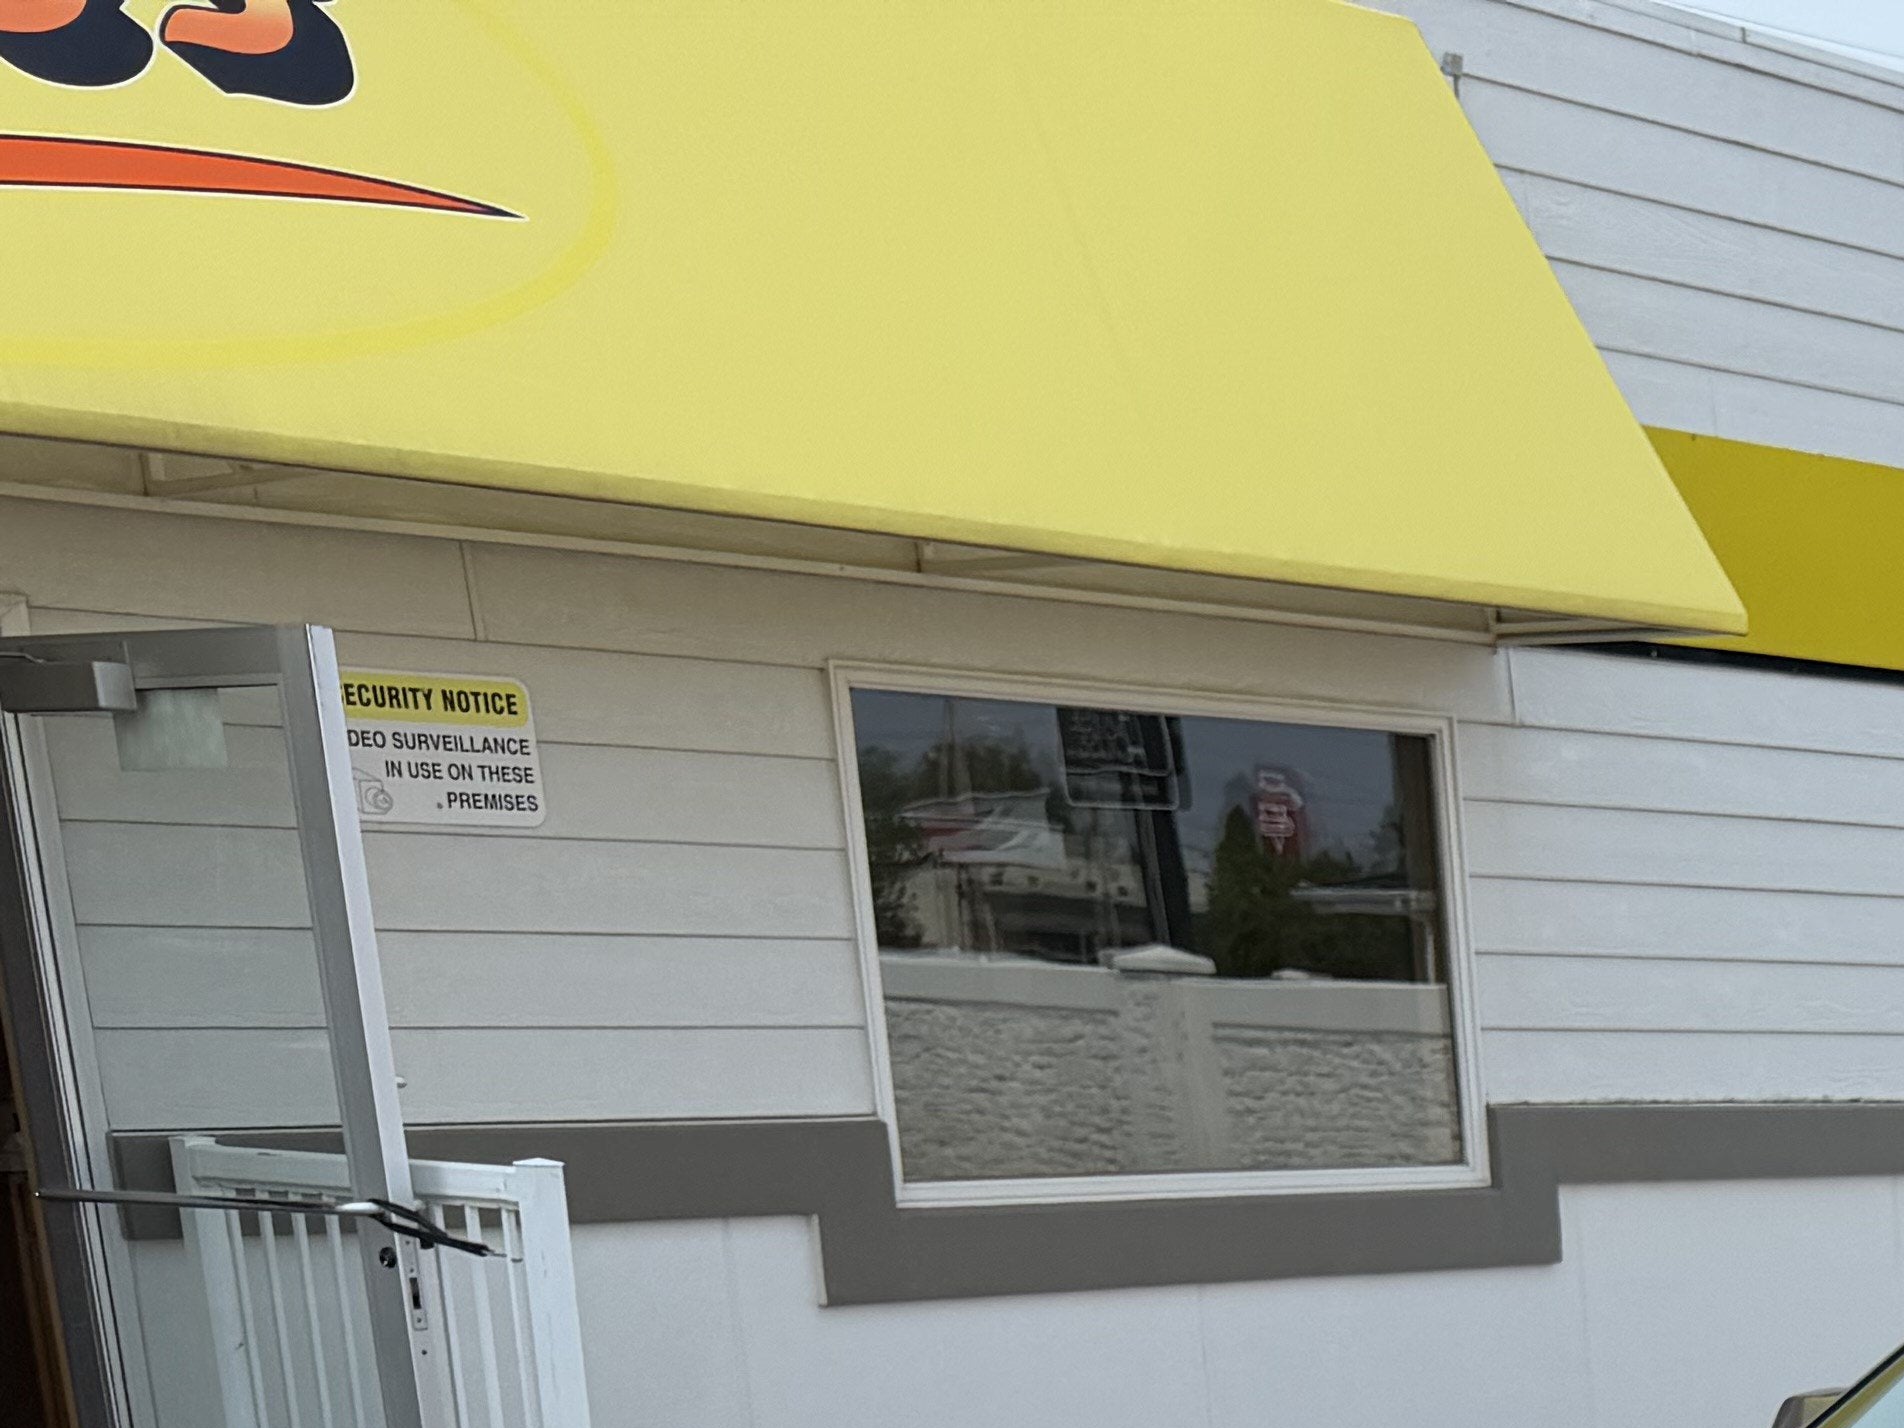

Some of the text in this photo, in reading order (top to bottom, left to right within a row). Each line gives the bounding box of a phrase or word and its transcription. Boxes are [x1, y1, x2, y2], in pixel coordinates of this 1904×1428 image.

[341, 683, 519, 716] ECURITY NOTICE
[348, 729, 532, 756] DEO SURVEILLANCE
[385, 760, 536, 784] IN USE ON THESE
[447, 792, 539, 812] PREMISES
